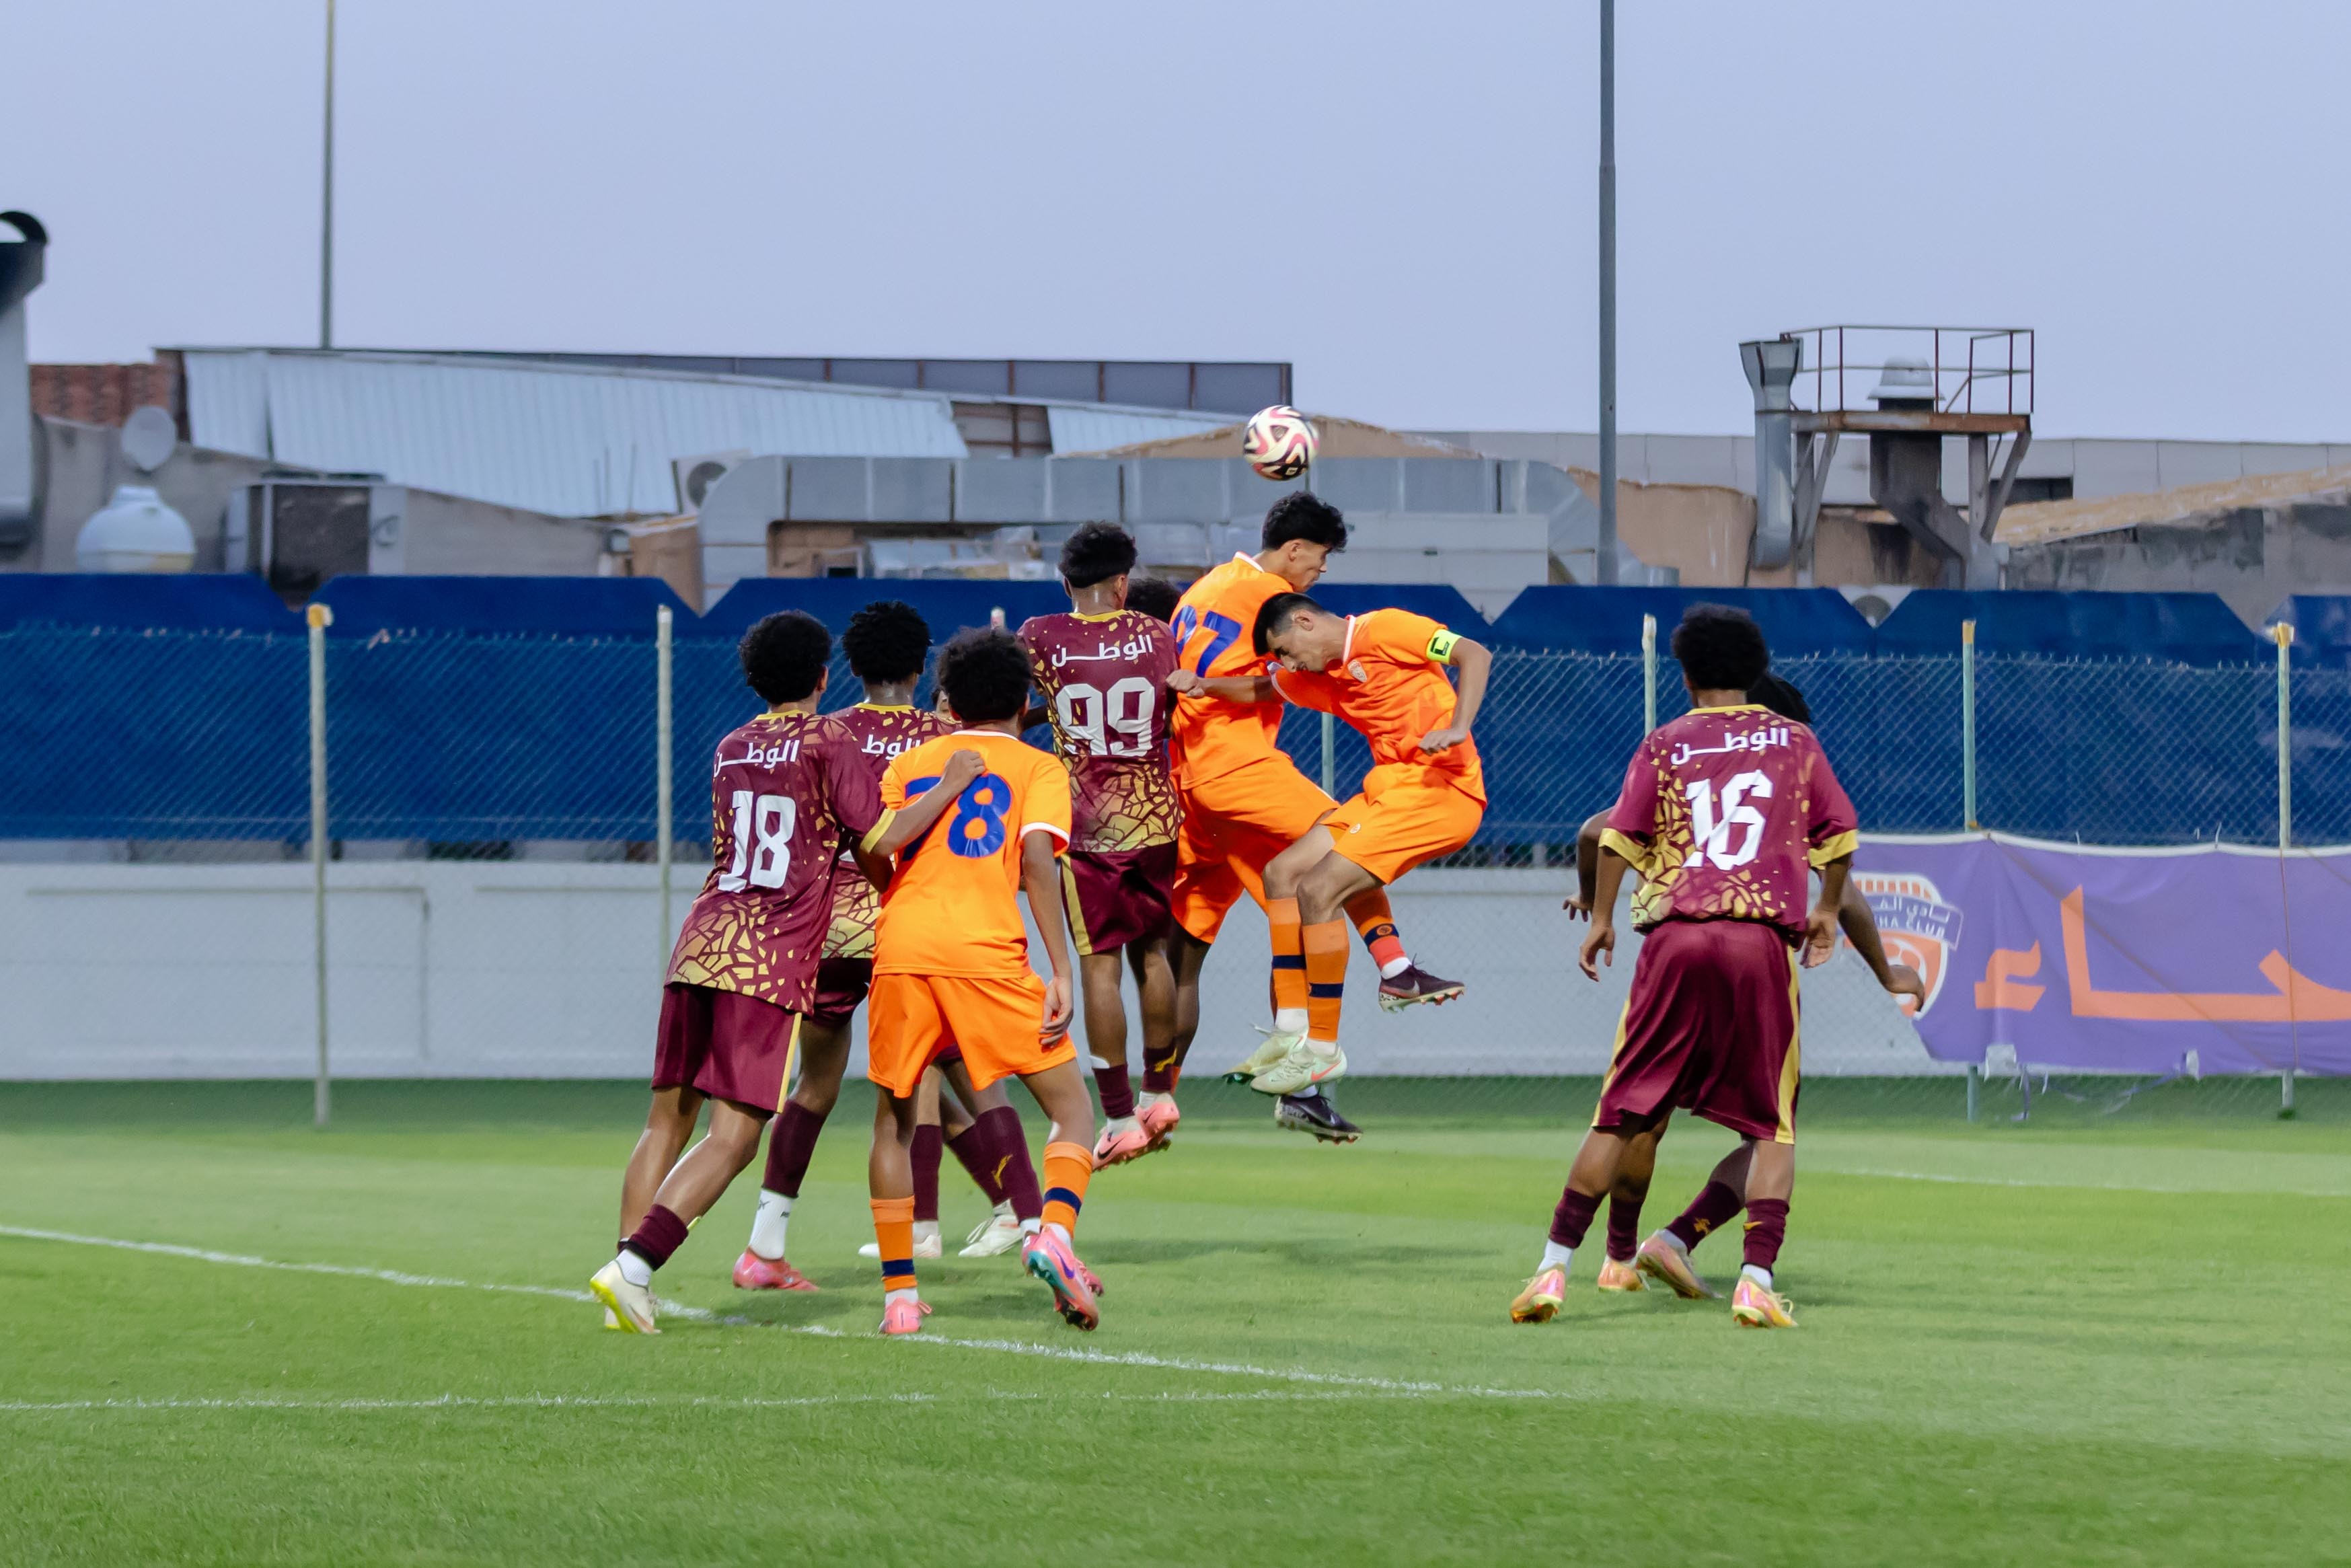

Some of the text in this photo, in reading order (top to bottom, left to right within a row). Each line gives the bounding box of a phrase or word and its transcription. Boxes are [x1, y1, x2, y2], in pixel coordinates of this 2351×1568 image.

[1051, 634, 1153, 667] الوطن
[1055, 677, 1156, 757] 99
[1670, 727, 1789, 765] الوطن
[713, 739, 800, 778] الوطن
[717, 790, 796, 893] 18
[1682, 769, 1774, 870] 16
